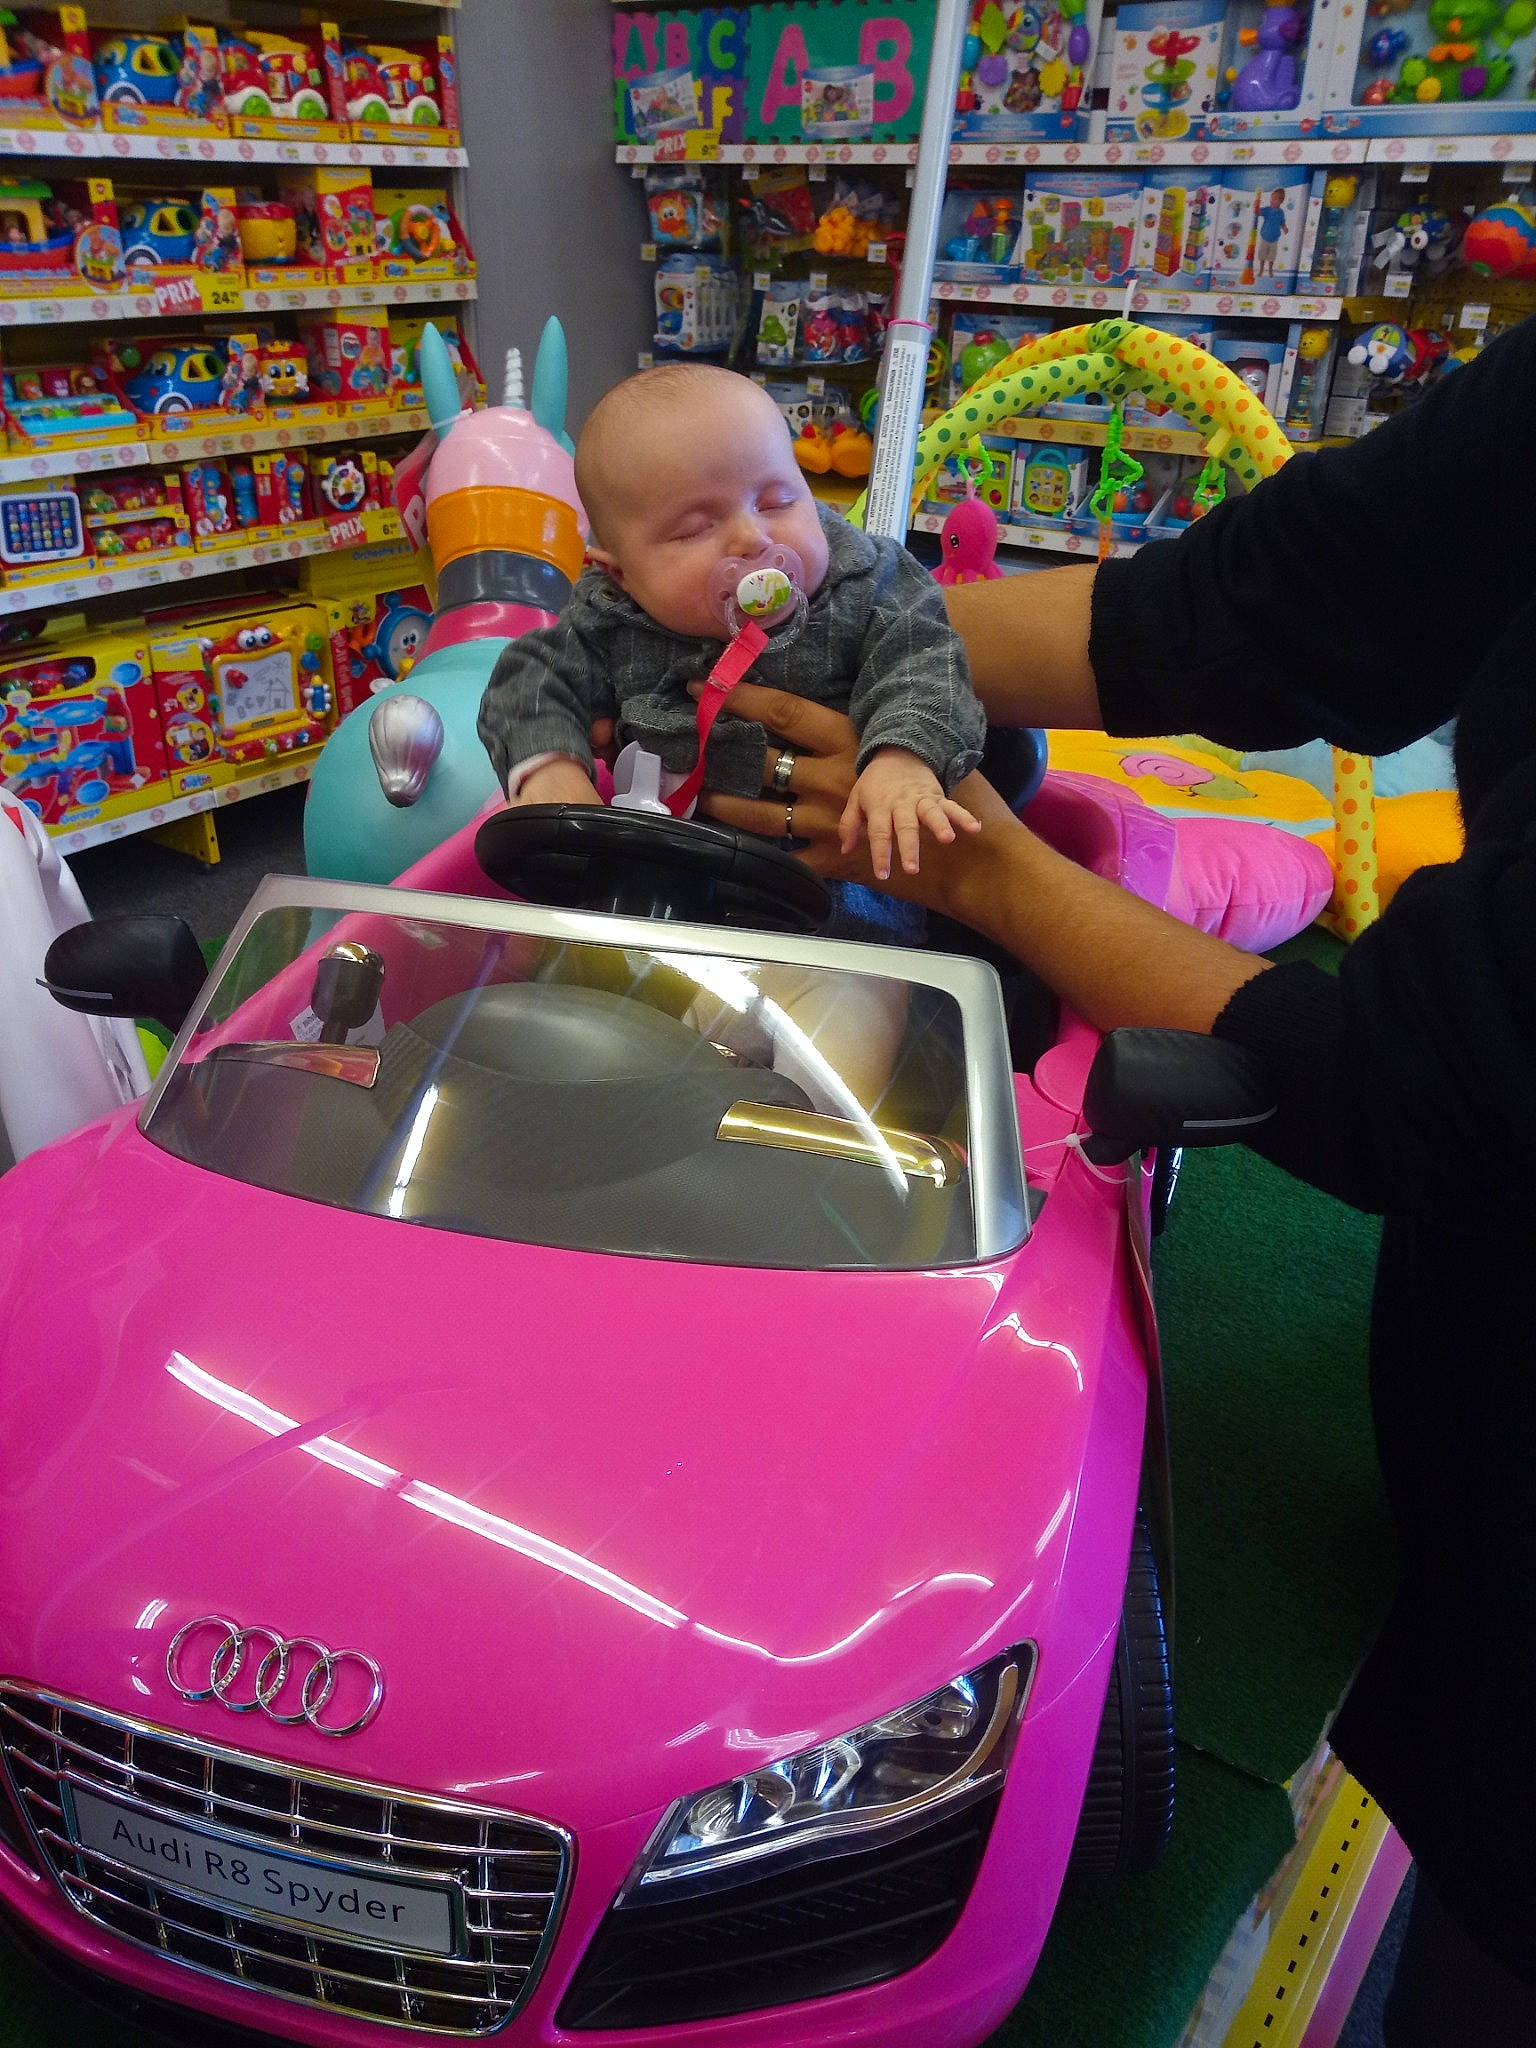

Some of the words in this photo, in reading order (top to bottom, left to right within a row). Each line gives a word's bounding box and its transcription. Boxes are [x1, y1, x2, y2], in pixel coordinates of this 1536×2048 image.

[156, 278, 201, 308] PRIX
[329, 516, 366, 544] PRIX
[112, 1819, 192, 1869] Audi
[204, 1850, 251, 1886] R8
[263, 1868, 406, 1923] Spyder
